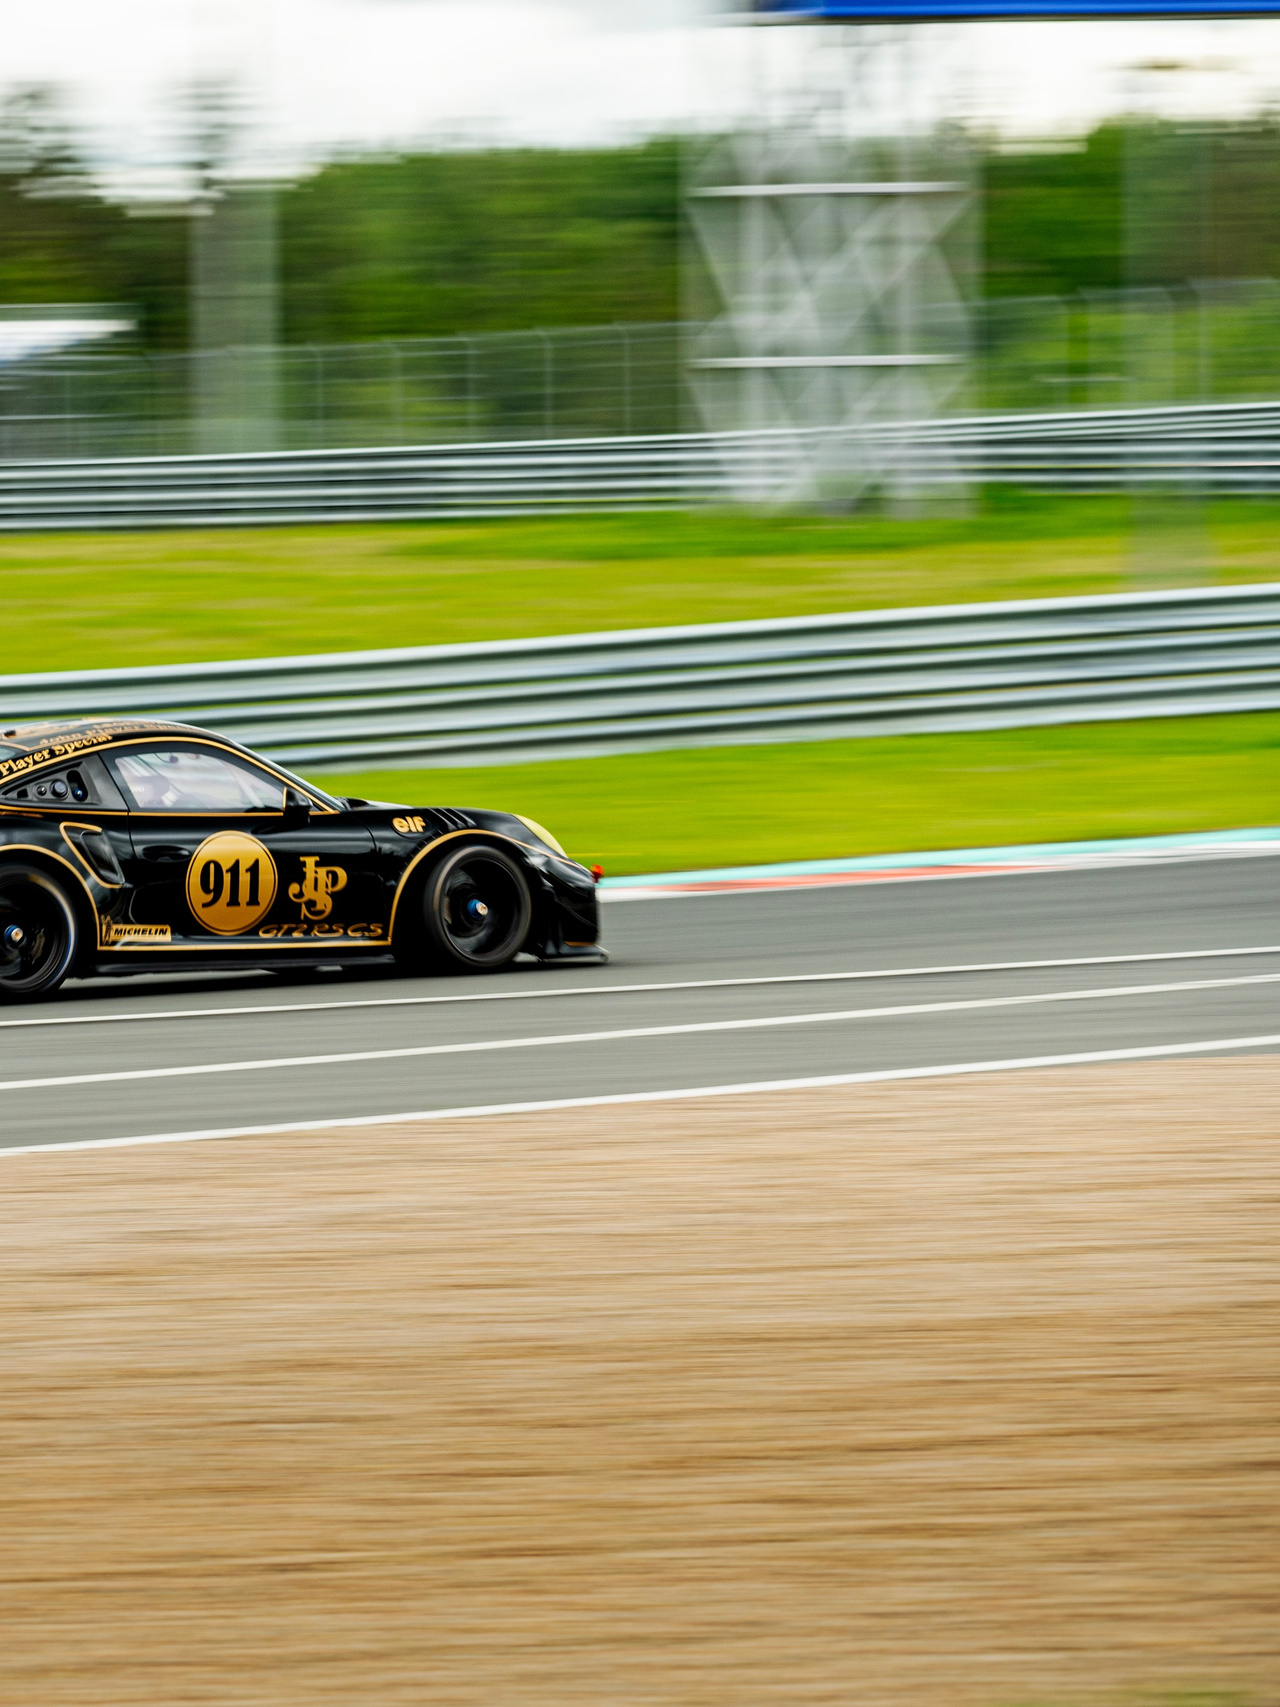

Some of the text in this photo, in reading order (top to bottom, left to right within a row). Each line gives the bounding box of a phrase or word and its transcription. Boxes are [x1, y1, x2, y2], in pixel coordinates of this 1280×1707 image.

[52, 733, 114, 756] Special
[392, 815, 426, 833] elf
[199, 858, 261, 908] 911
[114, 927, 168, 936] MICHELIN
